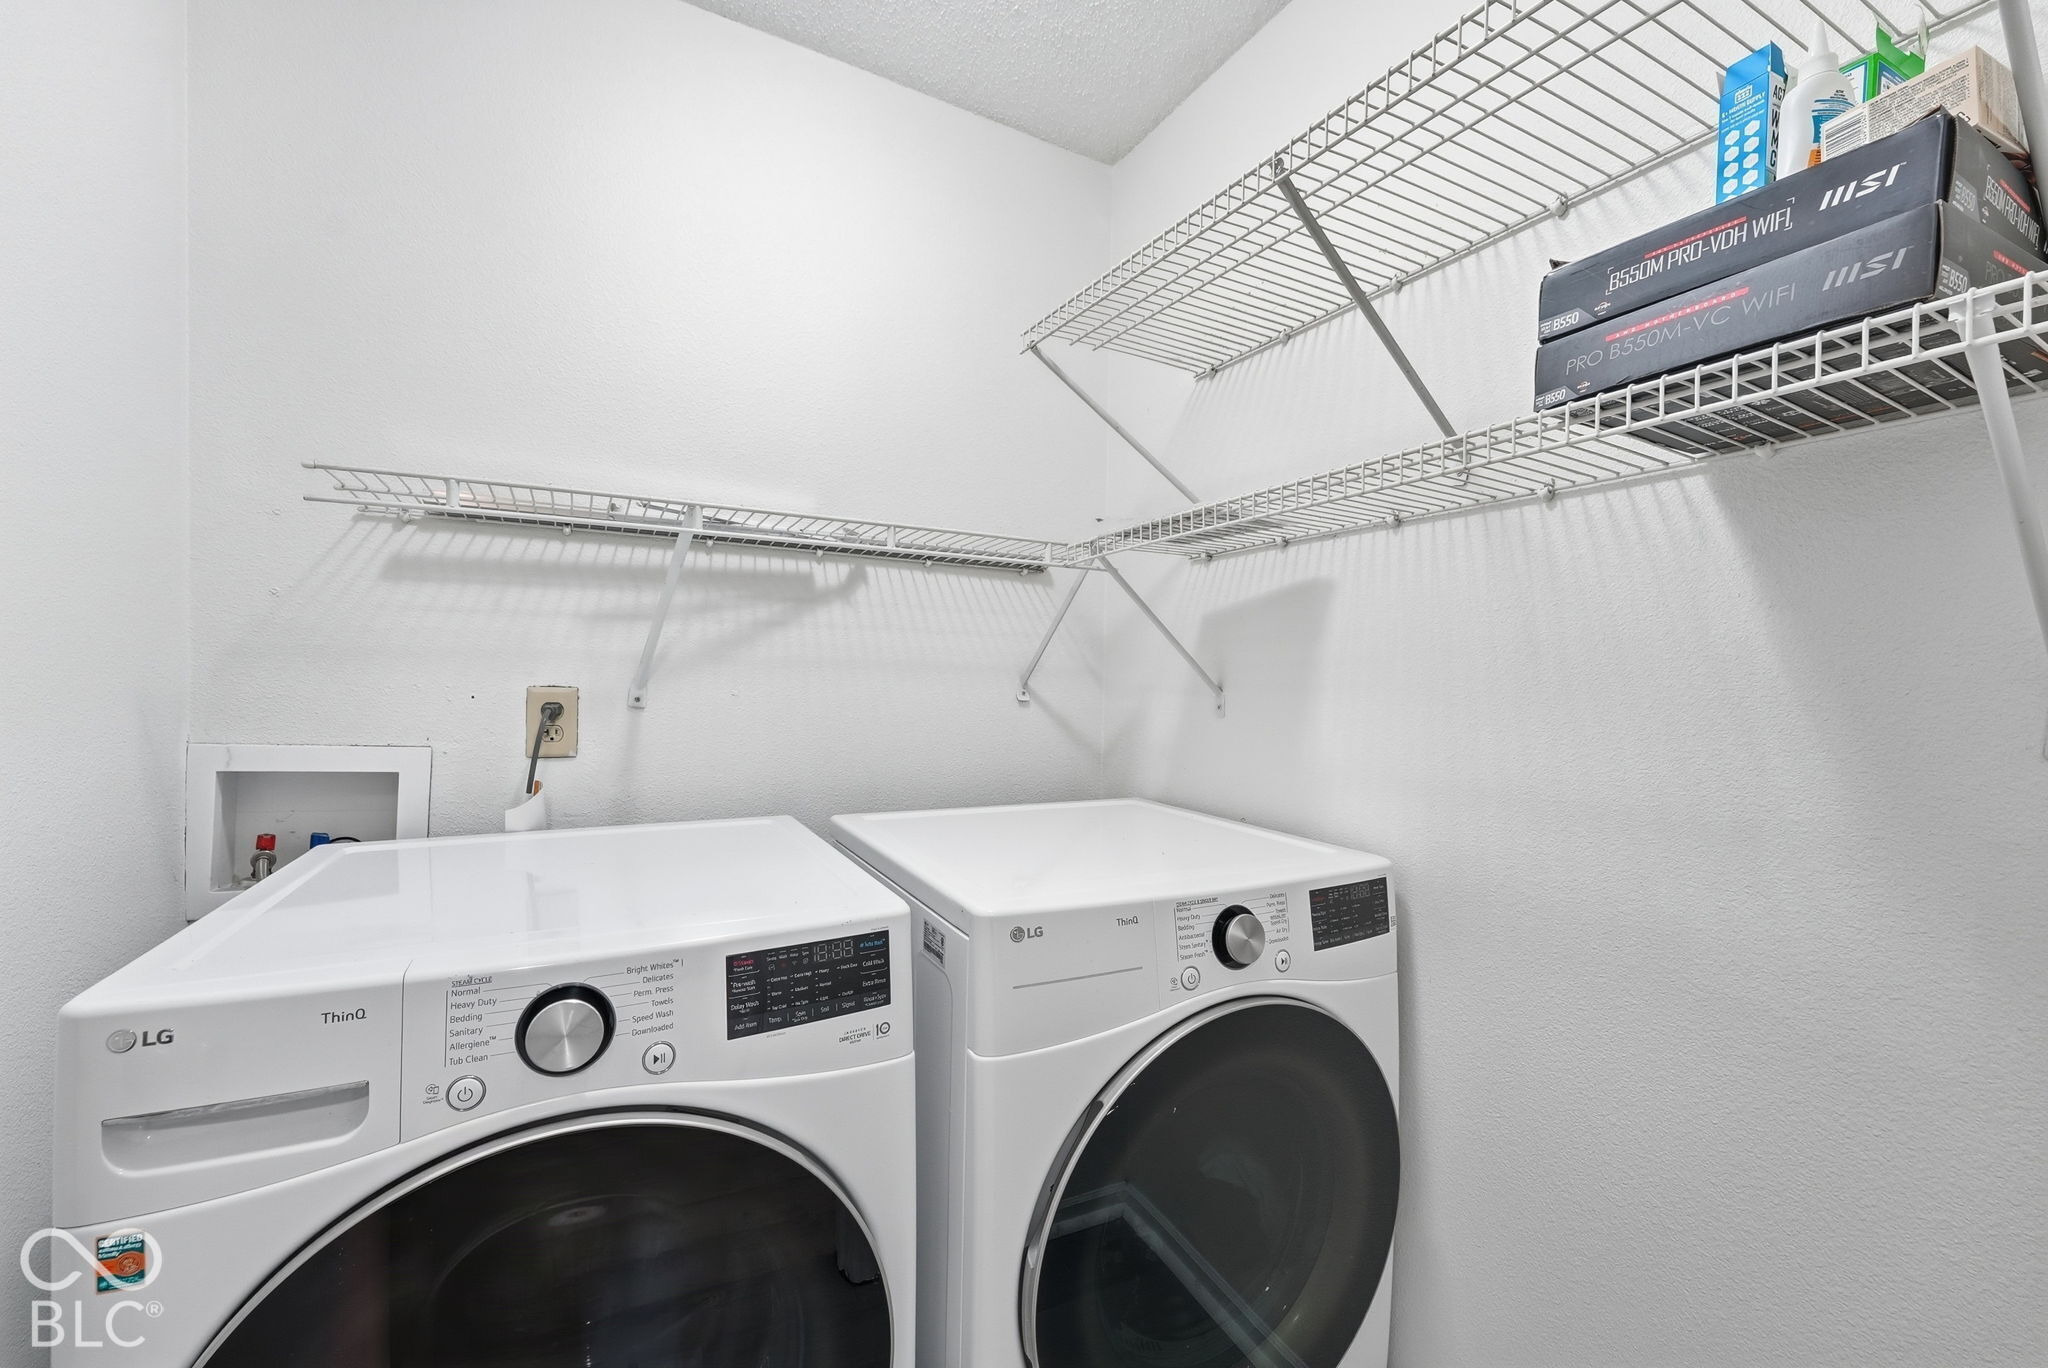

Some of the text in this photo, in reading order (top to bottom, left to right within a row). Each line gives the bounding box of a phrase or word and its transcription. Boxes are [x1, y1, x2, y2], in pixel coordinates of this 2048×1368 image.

[1609, 206, 1792, 292] B550M PRO-VDH WIFI
[1553, 311, 1579, 331] B550
[1566, 350, 1603, 376] PRO
[1609, 305, 1731, 361] B550M-VC
[1742, 282, 1796, 316] WIFI
[1545, 388, 1566, 405] B550
[1115, 915, 1139, 927] ThinQ
[1026, 926, 1044, 939] LG
[626, 966, 649, 975] Bright
[642, 973, 675, 984] Delicates
[451, 987, 481, 997] Normal
[655, 985, 675, 995] Press
[450, 998, 497, 1011] Heavy Duty
[651, 997, 675, 1007] Towels
[321, 1008, 367, 1025] ThinQ
[449, 1013, 483, 1024] Bedding
[631, 1009, 675, 1024] Speed Wash
[449, 1026, 484, 1038] Sanitary
[631, 1022, 675, 1037] Downloaded
[142, 1028, 175, 1047] LG
[449, 1053, 489, 1066] Tub Clean
